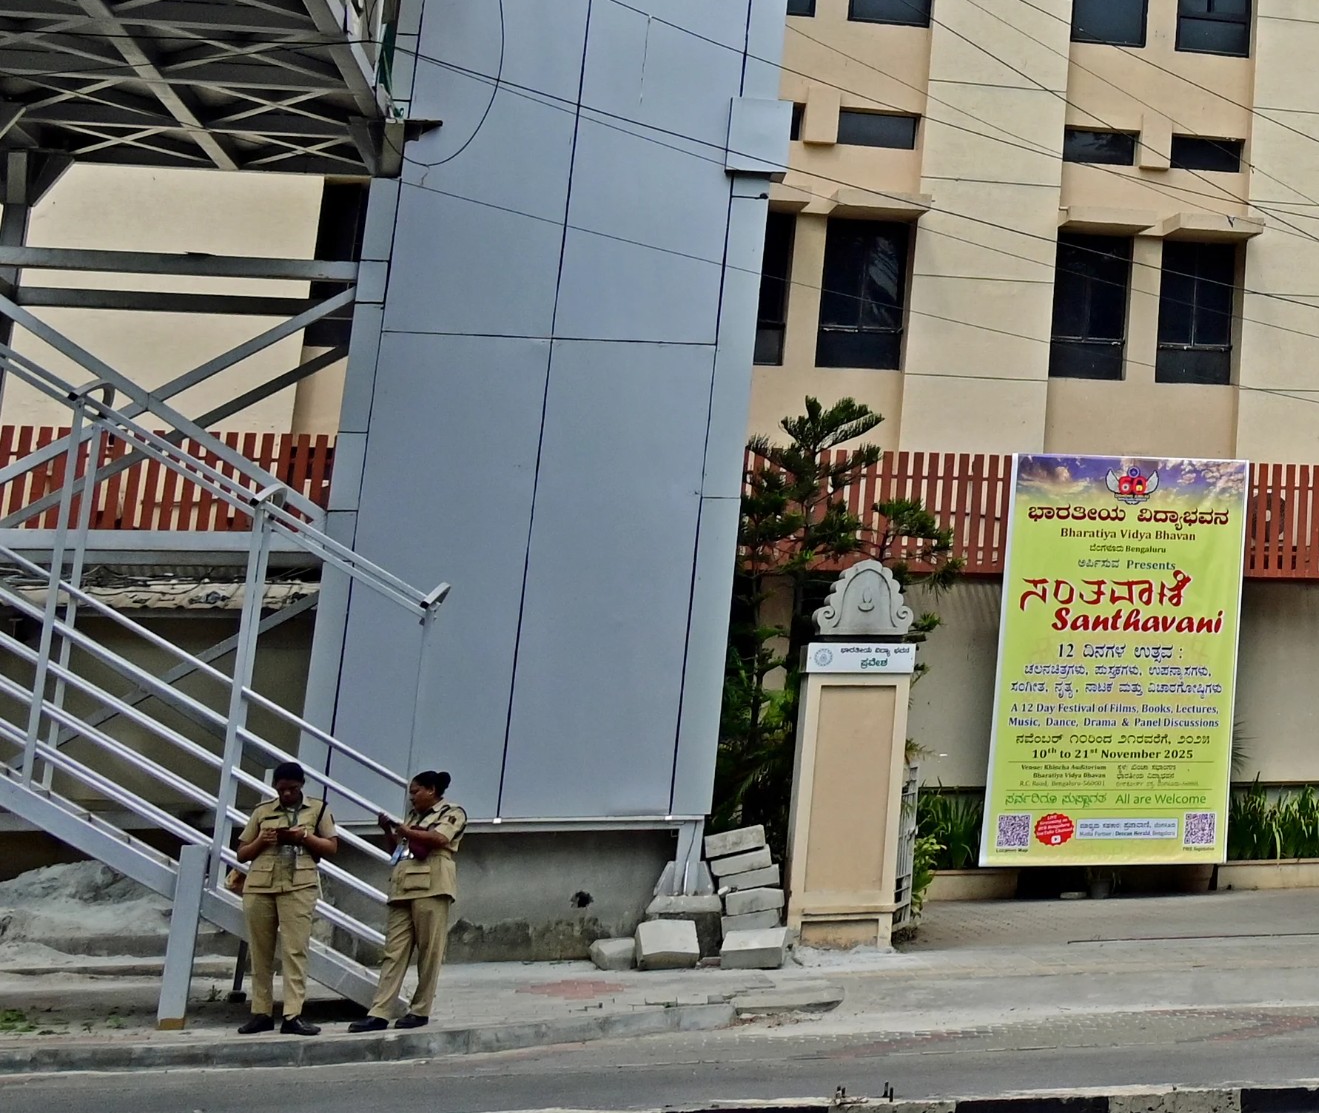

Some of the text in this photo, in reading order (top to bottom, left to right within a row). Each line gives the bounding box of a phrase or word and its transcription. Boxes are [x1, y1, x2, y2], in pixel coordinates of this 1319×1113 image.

[1028, 504, 1229, 530] ಭಾರತೀಯ ವಿದ್ಯಾಭವನ
[1060, 528, 1196, 541] Bharatiya Vidya Bhavan
[1125, 545, 1166, 554] Bengaluru
[1126, 560, 1176, 570] Presents
[1019, 569, 1192, 611] ಸಂತವಾಣಿ
[1051, 607, 1224, 634] Santhavani
[1058, 643, 1074, 658] 12
[1083, 643, 1126, 658] ದಿನಗಳ
[1134, 644, 1174, 663] ಉತ್ಸವ
[860, 658, 888, 669] ಪ್ರವೇಶ
[1085, 682, 1113, 693] ನಾಟಕ
[1119, 682, 1143, 696] ಮತ್ತು
[1011, 703, 1219, 715] A 12 Day Festival of Films, Books, Lectures,
[1009, 717, 1219, 728] Music, Dance, Drama & Panel Discussions
[1016, 734, 1063, 744] ನವೆಂಬರ್
[1032, 747, 1057, 759] 10th
[1060, 749, 1071, 759] to
[1101, 749, 1162, 759] November
[1164, 749, 1193, 759] 2025
[1115, 793, 1130, 804] All
[1133, 795, 1152, 804] are
[1154, 794, 1207, 804] Welcome
